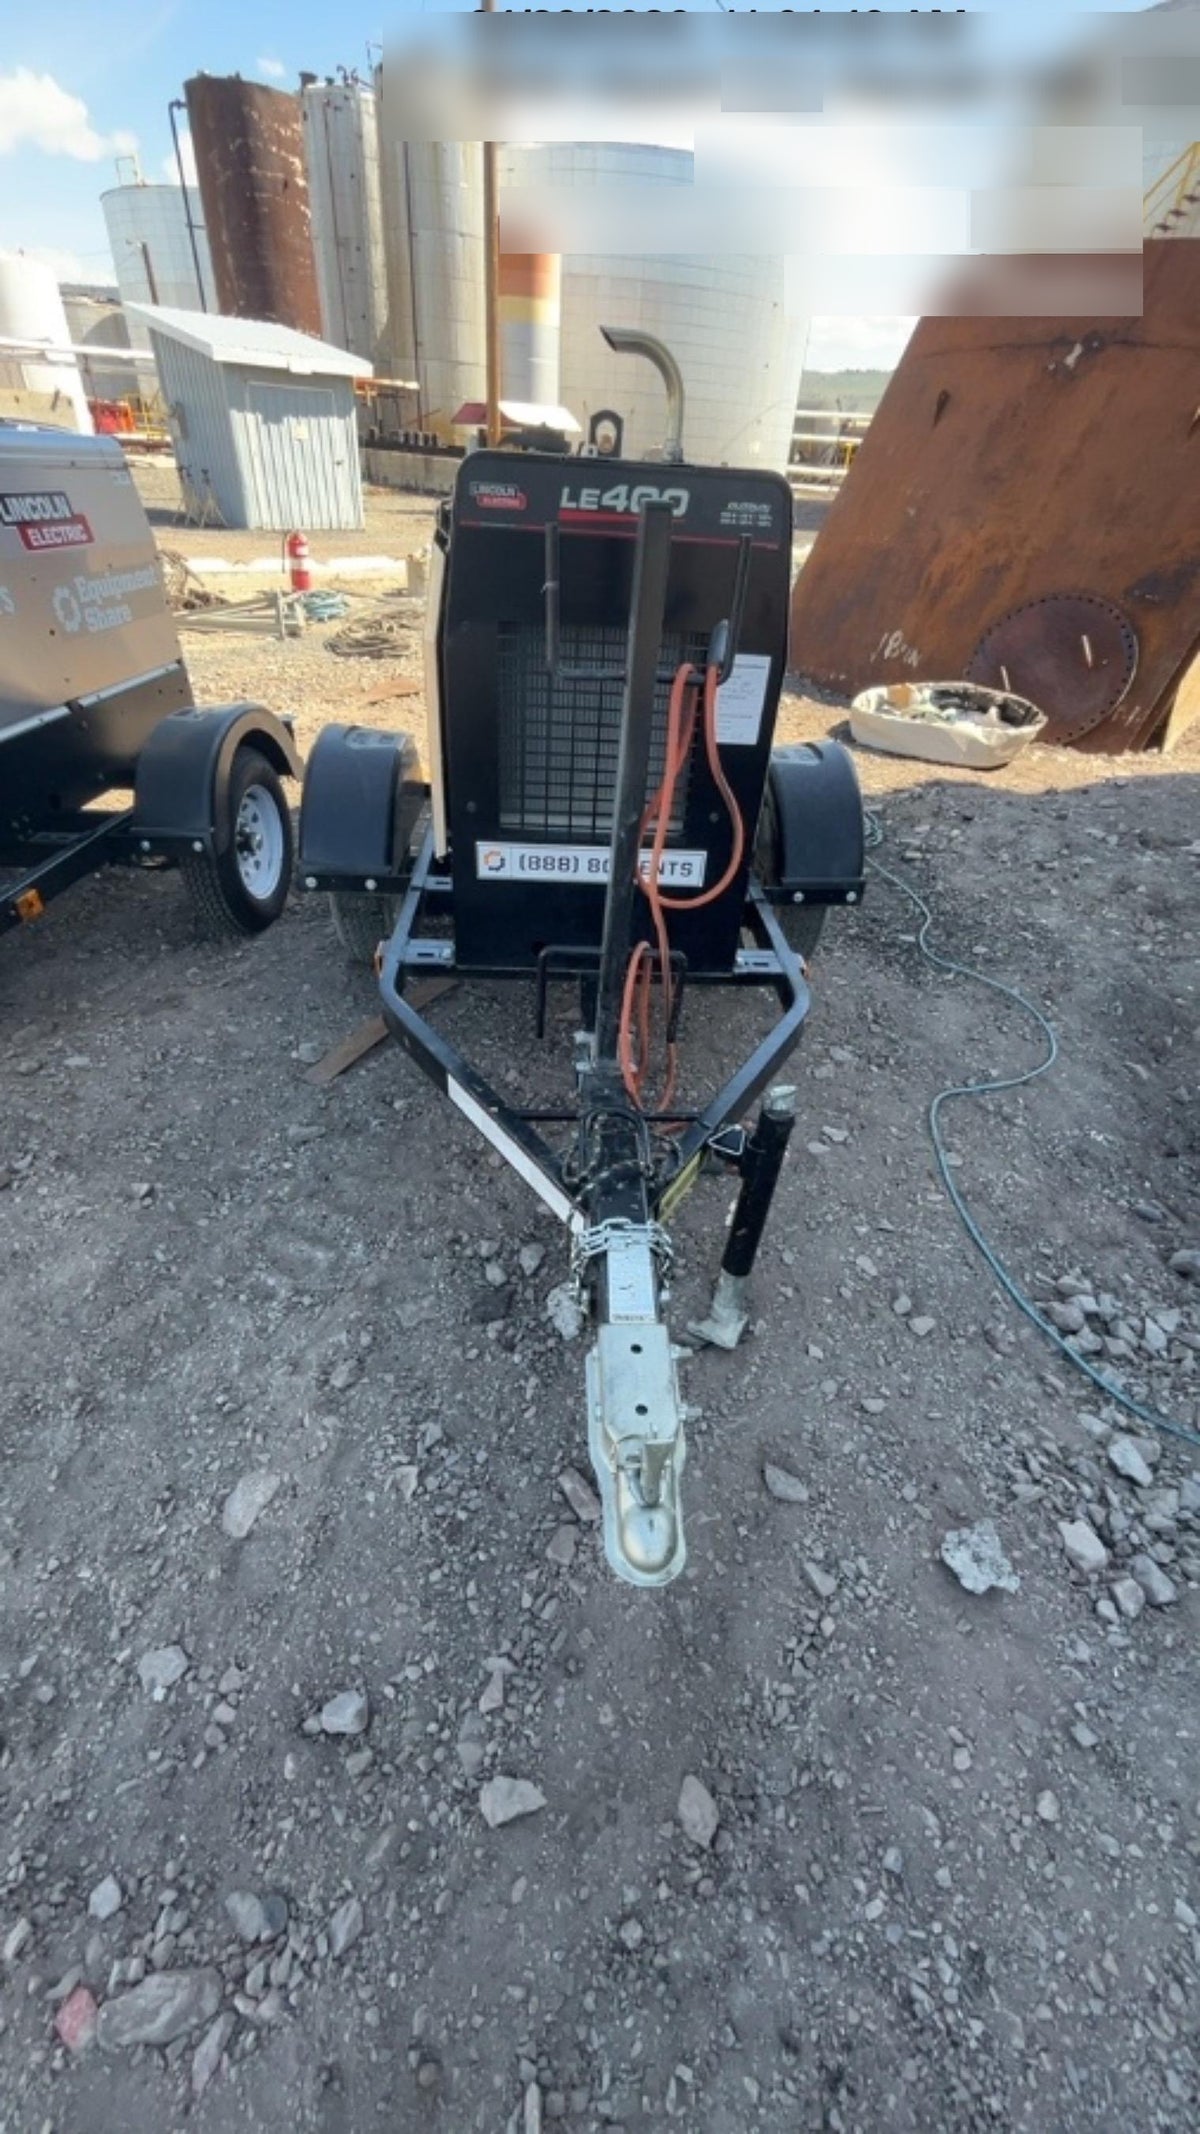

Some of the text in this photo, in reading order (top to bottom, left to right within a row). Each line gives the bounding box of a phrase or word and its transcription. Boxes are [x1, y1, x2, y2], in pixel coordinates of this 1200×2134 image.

[1, 495, 72, 523] LINCOLN
[28, 524, 88, 547] ELECTRIC
[73, 566, 158, 605] Equipment
[84, 604, 133, 632] Share
[519, 854, 580, 873] (888)
